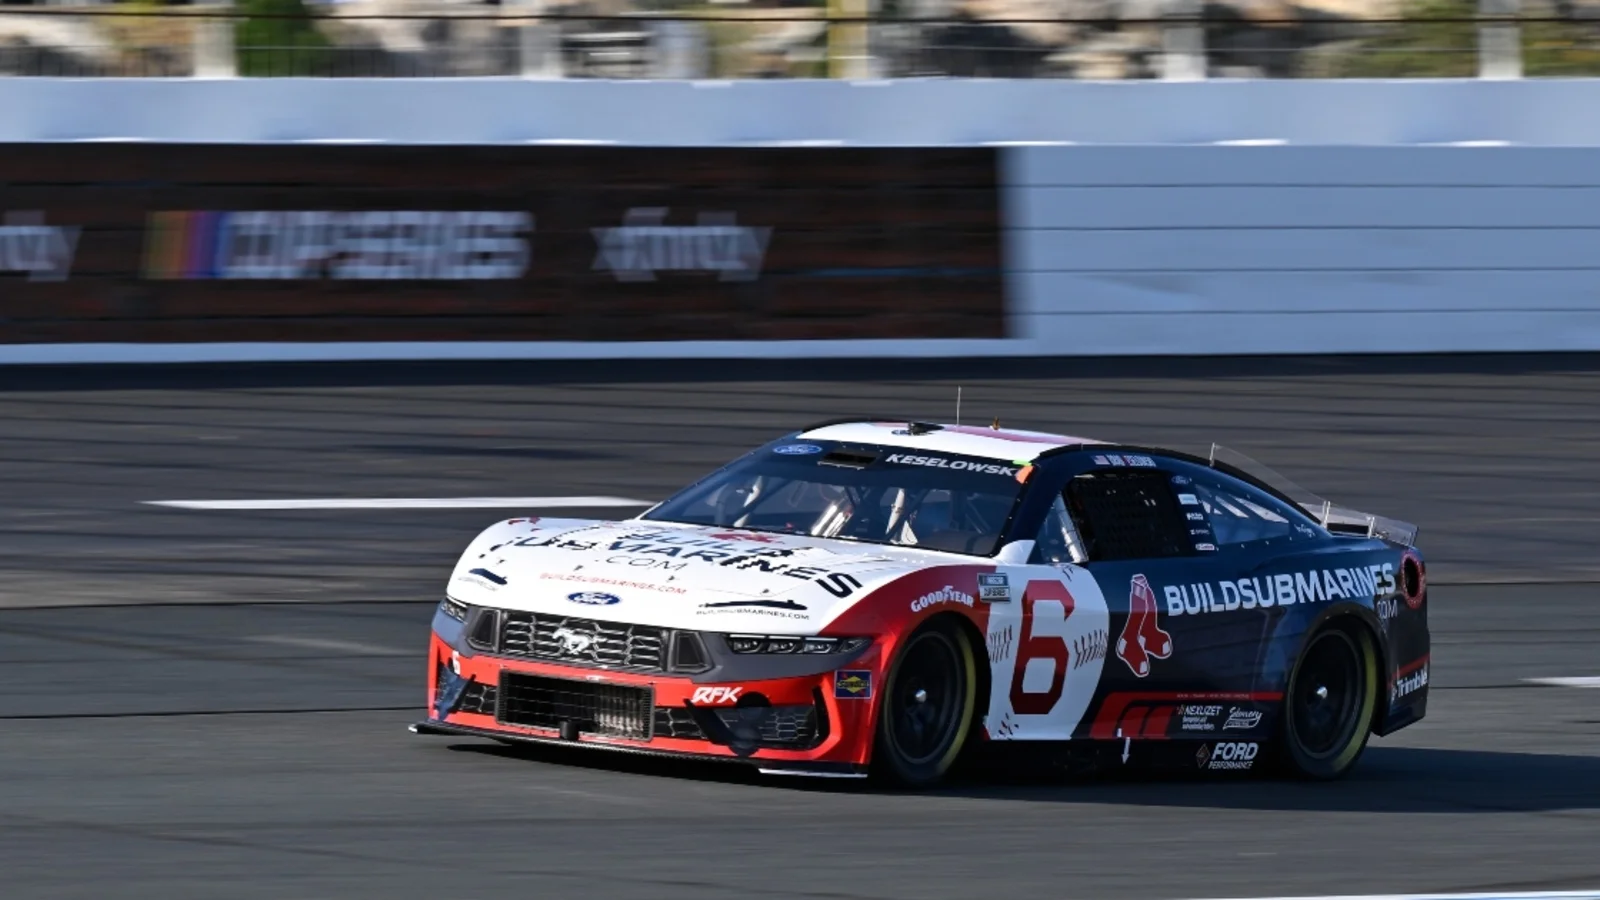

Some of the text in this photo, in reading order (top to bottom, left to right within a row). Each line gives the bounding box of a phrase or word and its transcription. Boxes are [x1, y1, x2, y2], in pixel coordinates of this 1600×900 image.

[886, 454, 1017, 477] KESELOWSK
[910, 585, 974, 612] GOODYEAR
[1164, 562, 1395, 616] BUILDSUBMARINES
[1009, 580, 1075, 714] 6
[690, 686, 744, 704] RFK
[1396, 669, 1428, 698] Trimble
[1211, 742, 1259, 760] FORD
[1208, 761, 1253, 769] PERFORMANCE
